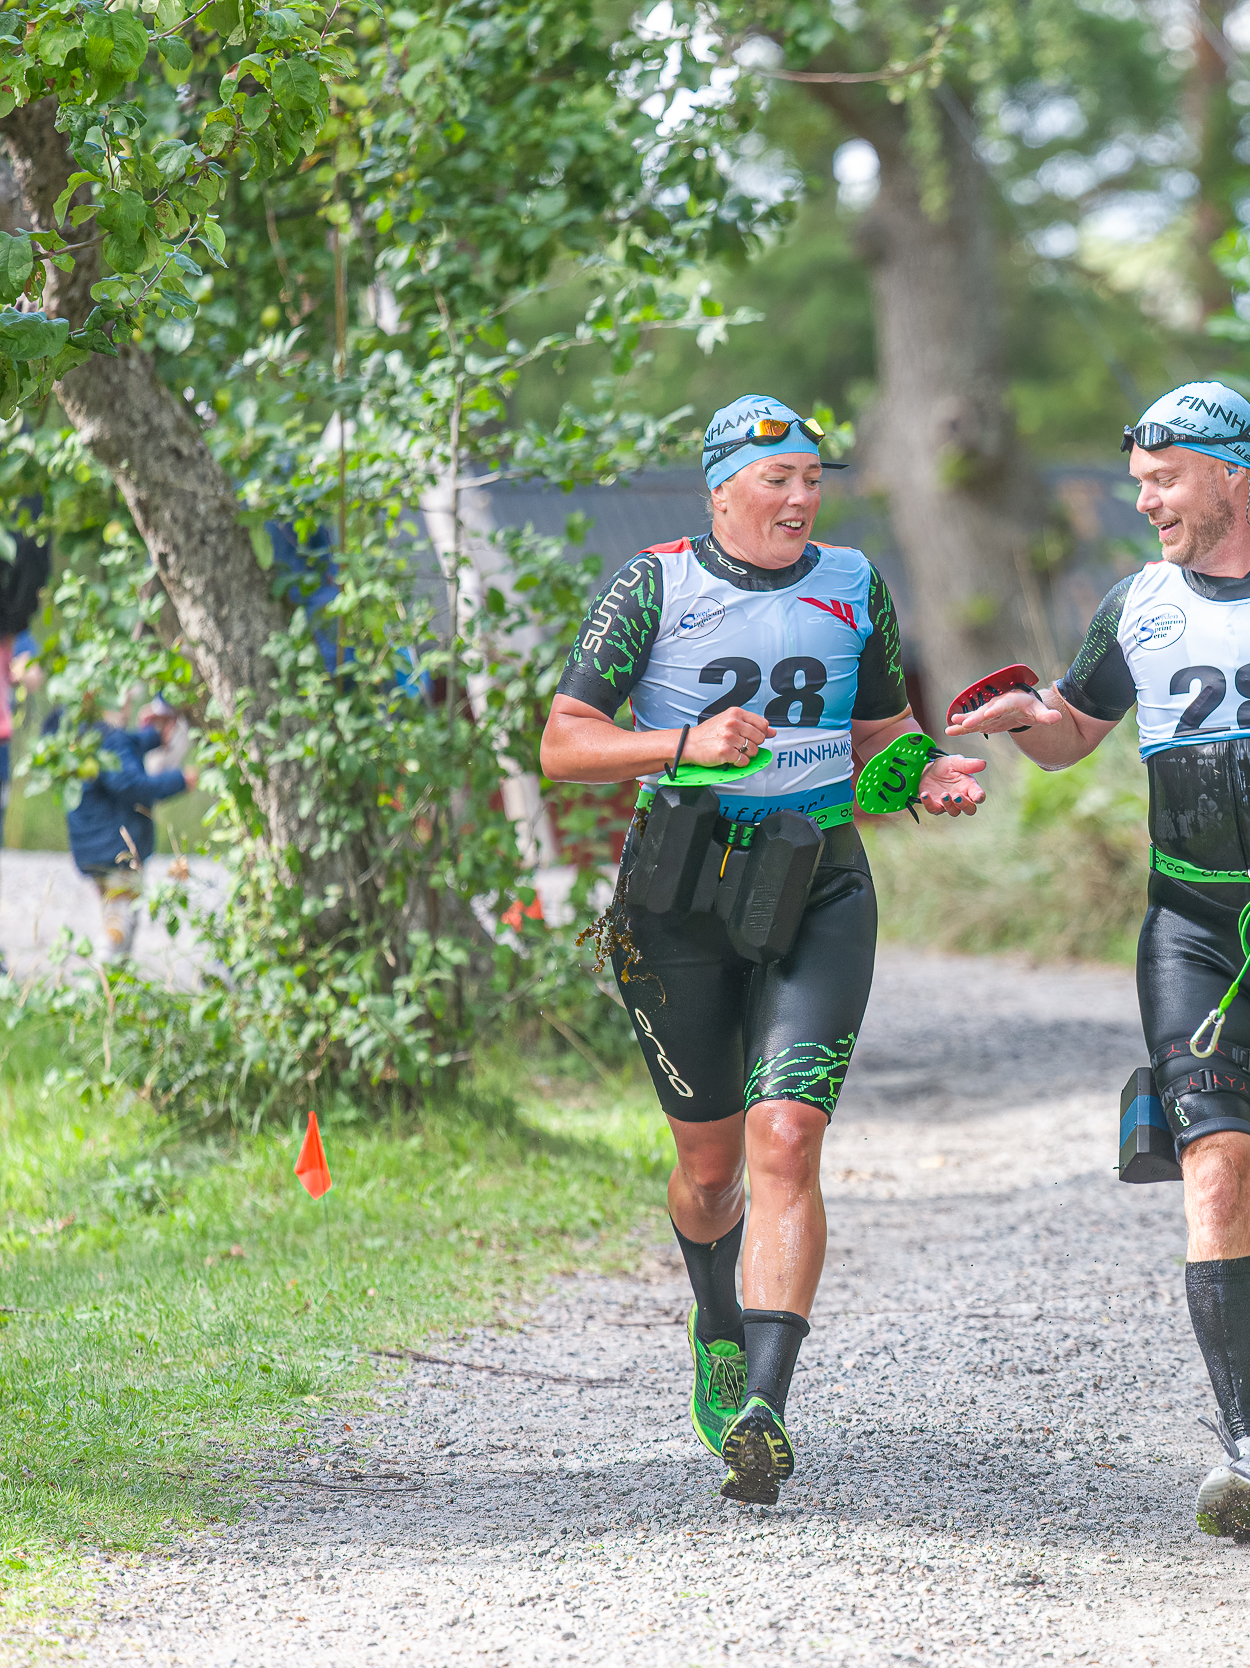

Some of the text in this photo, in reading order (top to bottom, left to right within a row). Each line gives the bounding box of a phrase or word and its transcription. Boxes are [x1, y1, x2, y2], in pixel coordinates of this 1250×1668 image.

[806, 616, 844, 625] orc
[697, 655, 828, 727] 28
[1155, 855, 1186, 874] orca
[635, 1008, 694, 1098] orca
[1174, 1098, 1191, 1127] rca
